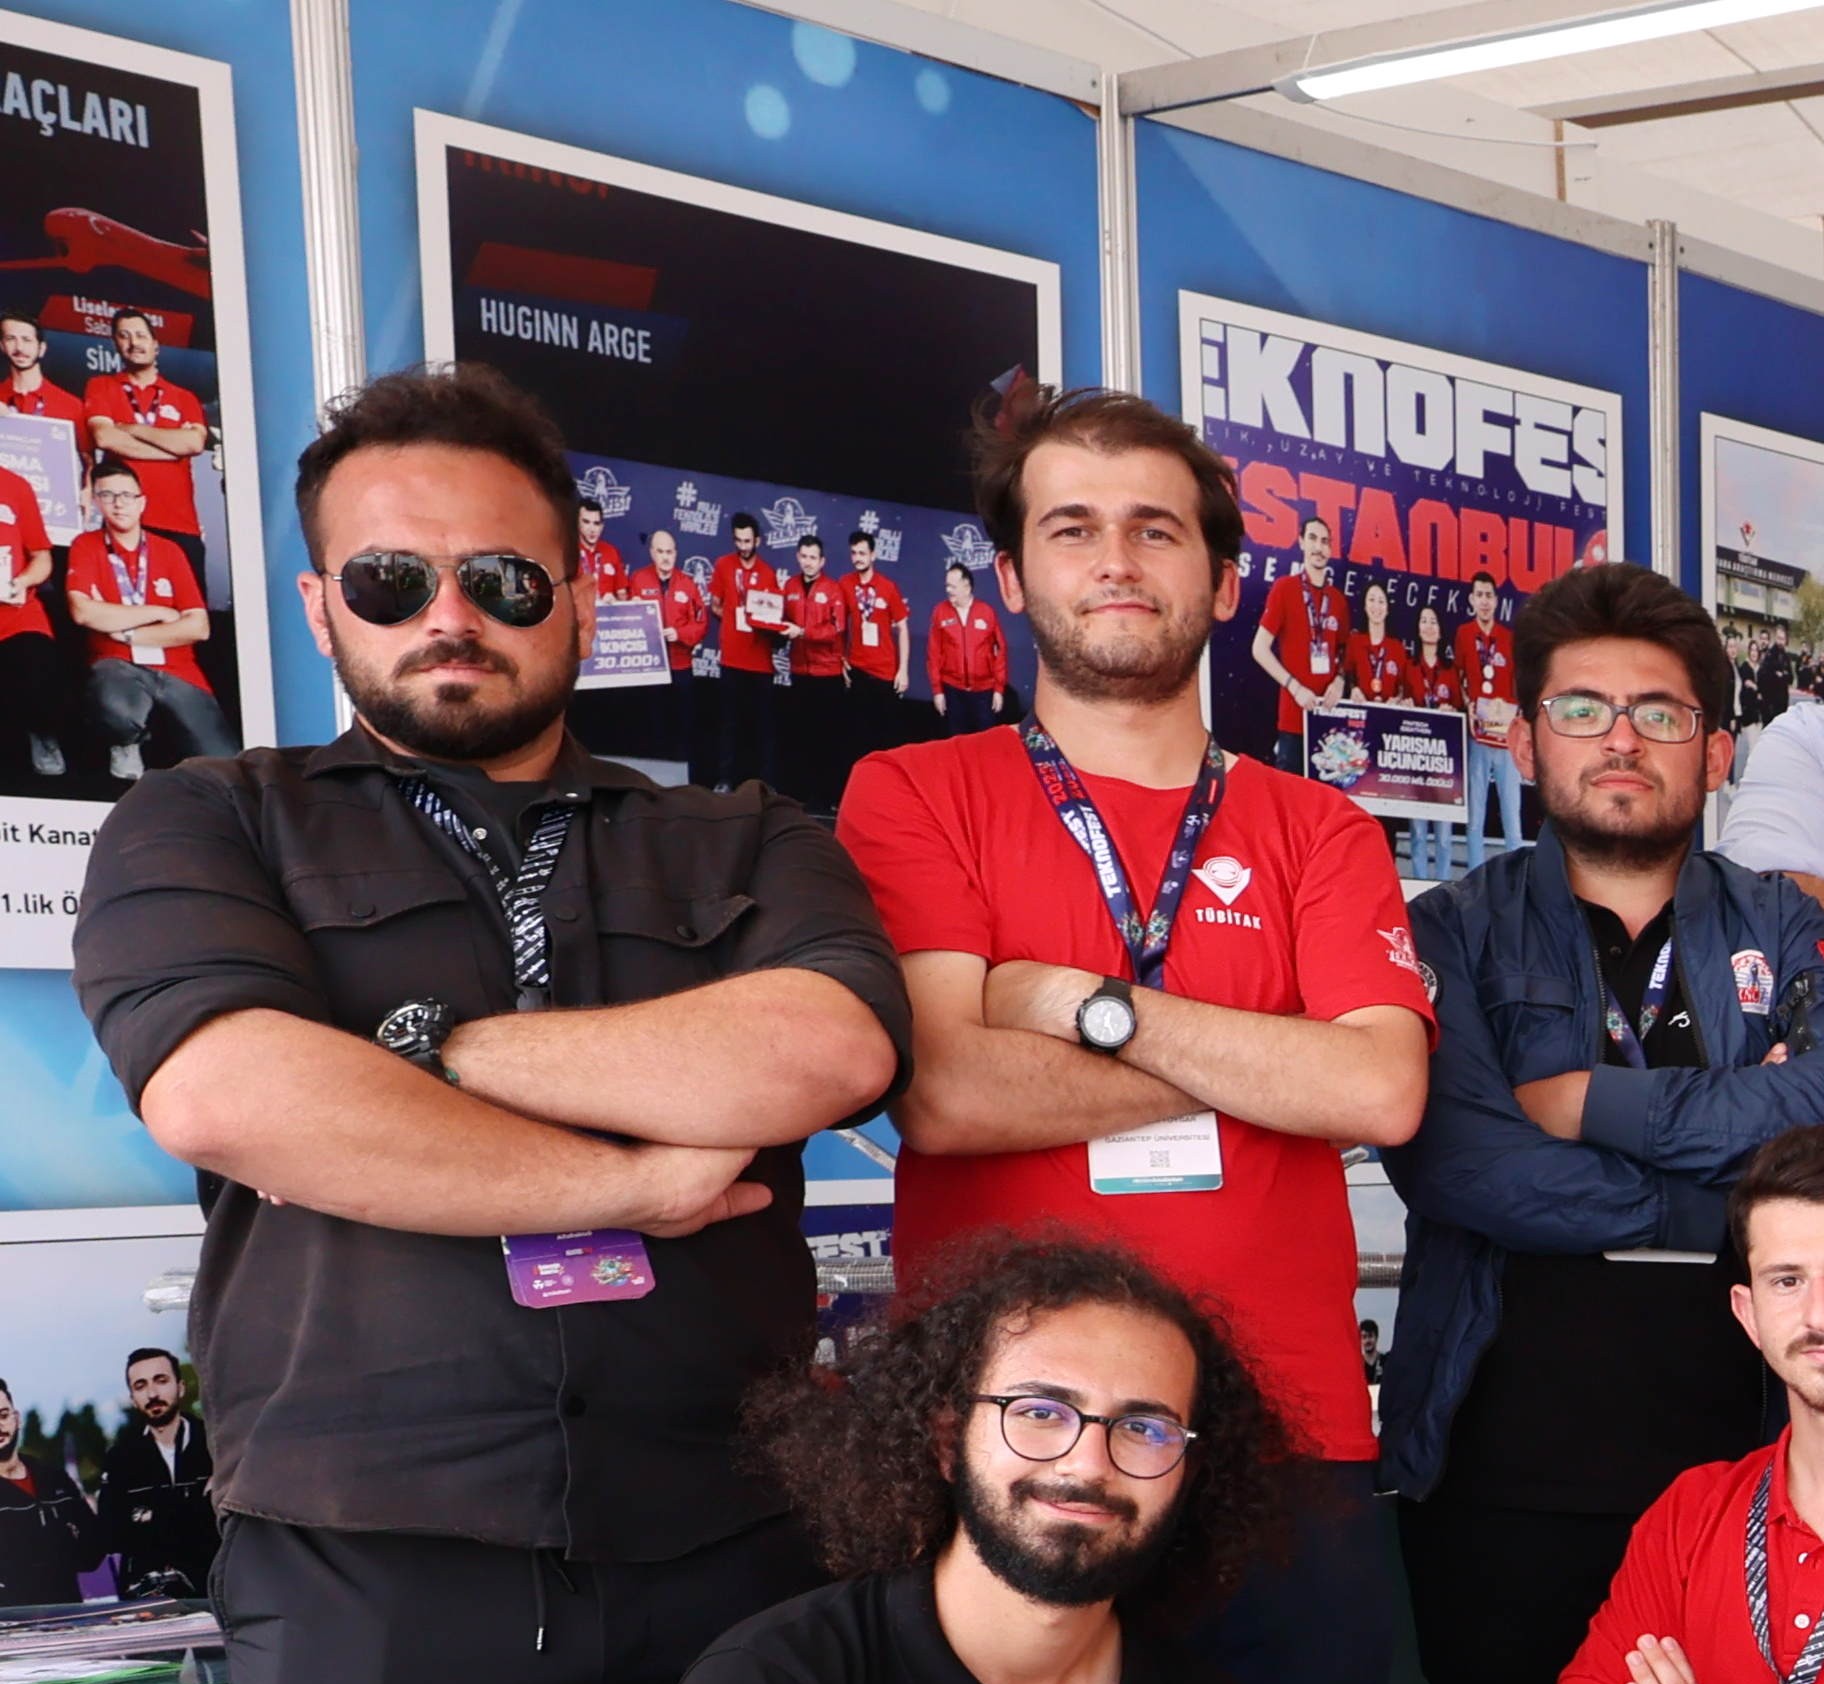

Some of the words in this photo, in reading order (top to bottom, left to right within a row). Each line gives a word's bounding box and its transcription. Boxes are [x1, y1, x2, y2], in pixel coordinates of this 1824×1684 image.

[0, 71, 149, 148] AÇLARI
[480, 297, 579, 350] HUGINN
[587, 320, 652, 364] ARGE
[2, 893, 54, 915] 1.lik
[1195, 908, 1262, 930] TÜBİTAK
